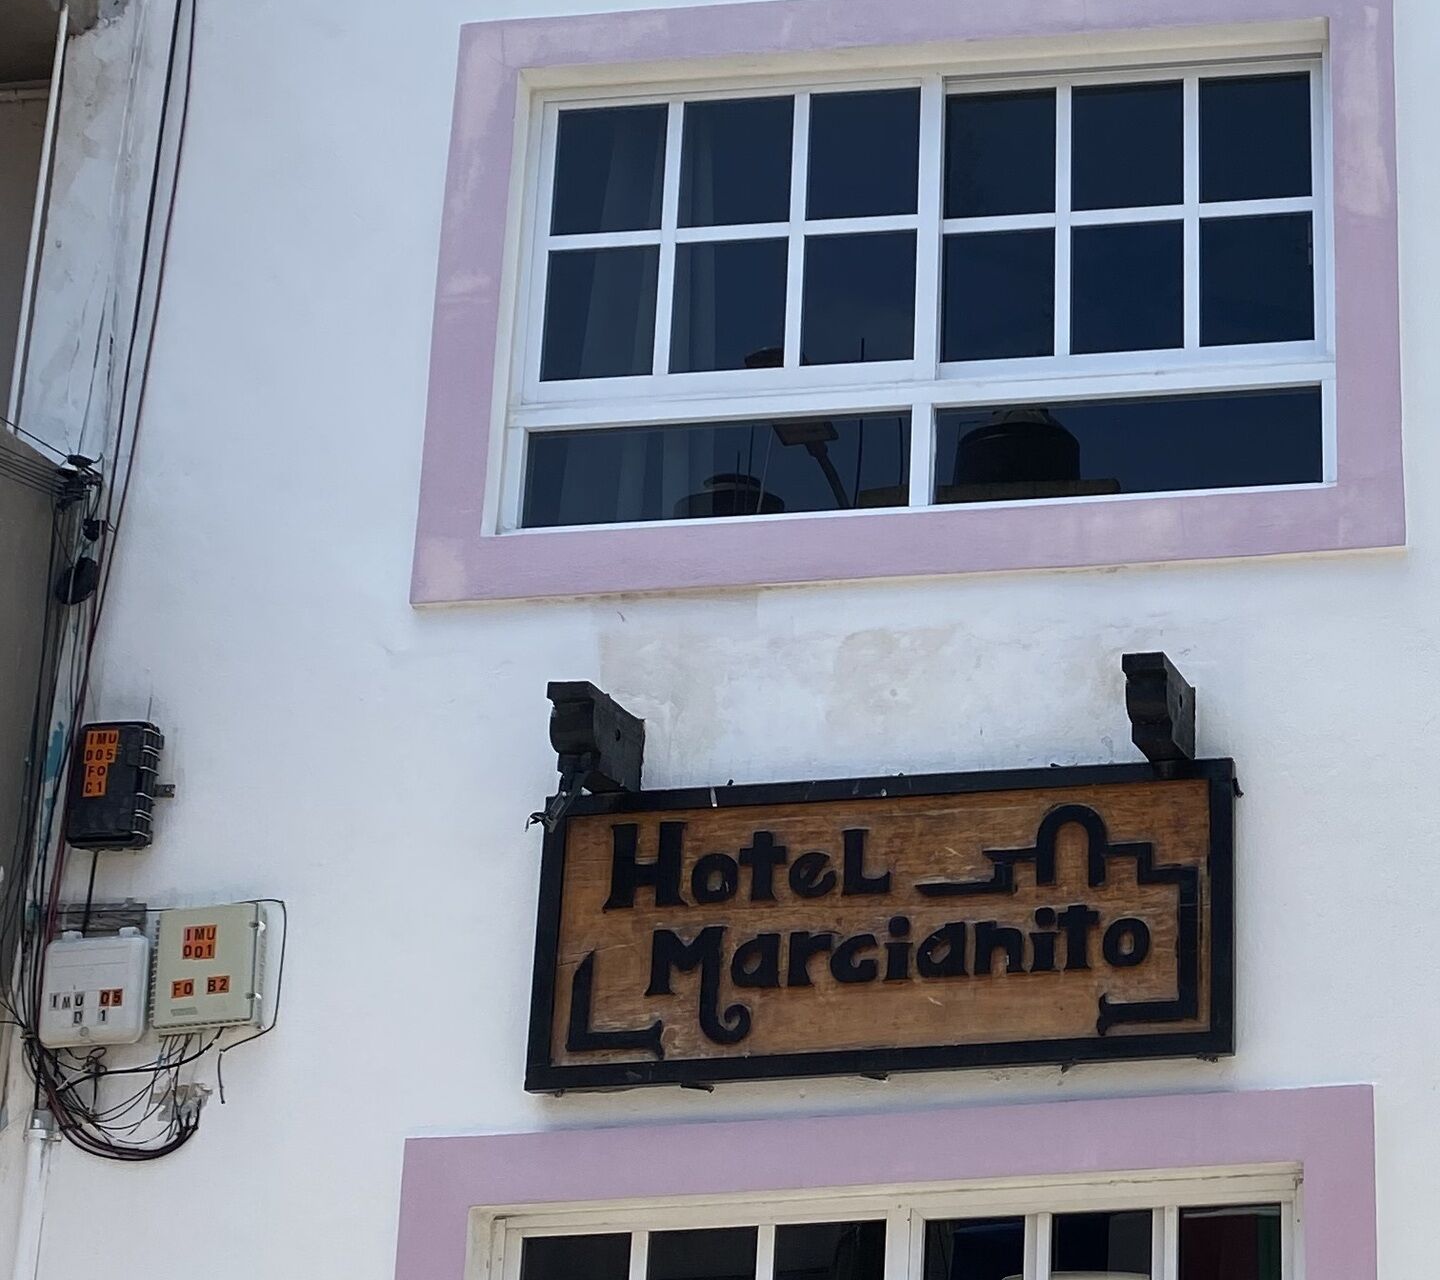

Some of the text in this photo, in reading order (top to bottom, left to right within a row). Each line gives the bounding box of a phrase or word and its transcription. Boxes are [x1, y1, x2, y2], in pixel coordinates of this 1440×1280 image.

[89, 732, 117, 745] IMU
[186, 926, 216, 941] IMU
[645, 904, 1152, 1045] Marcianito
[207, 978, 228, 993] B2
